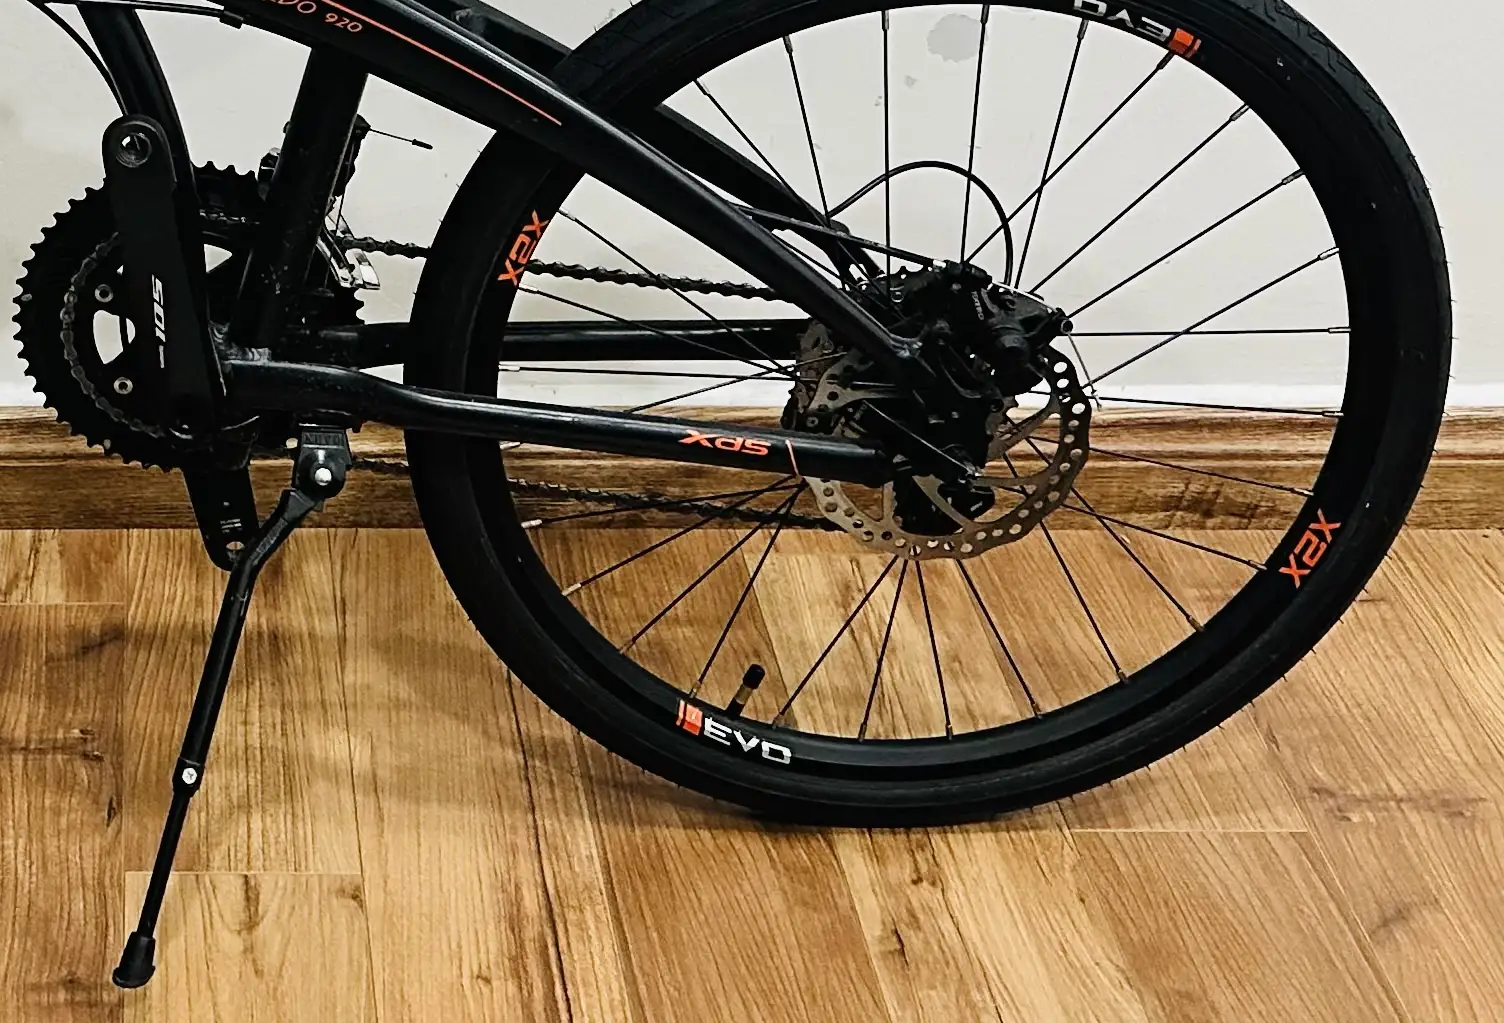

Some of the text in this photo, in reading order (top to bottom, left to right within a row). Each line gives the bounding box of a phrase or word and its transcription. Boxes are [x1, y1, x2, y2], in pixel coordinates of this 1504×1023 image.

[325, 12, 363, 32] 920
[497, 209, 550, 287] X2X
[151, 274, 166, 343] 105
[1278, 507, 1342, 589] X2X
[703, 716, 793, 765] EVO
